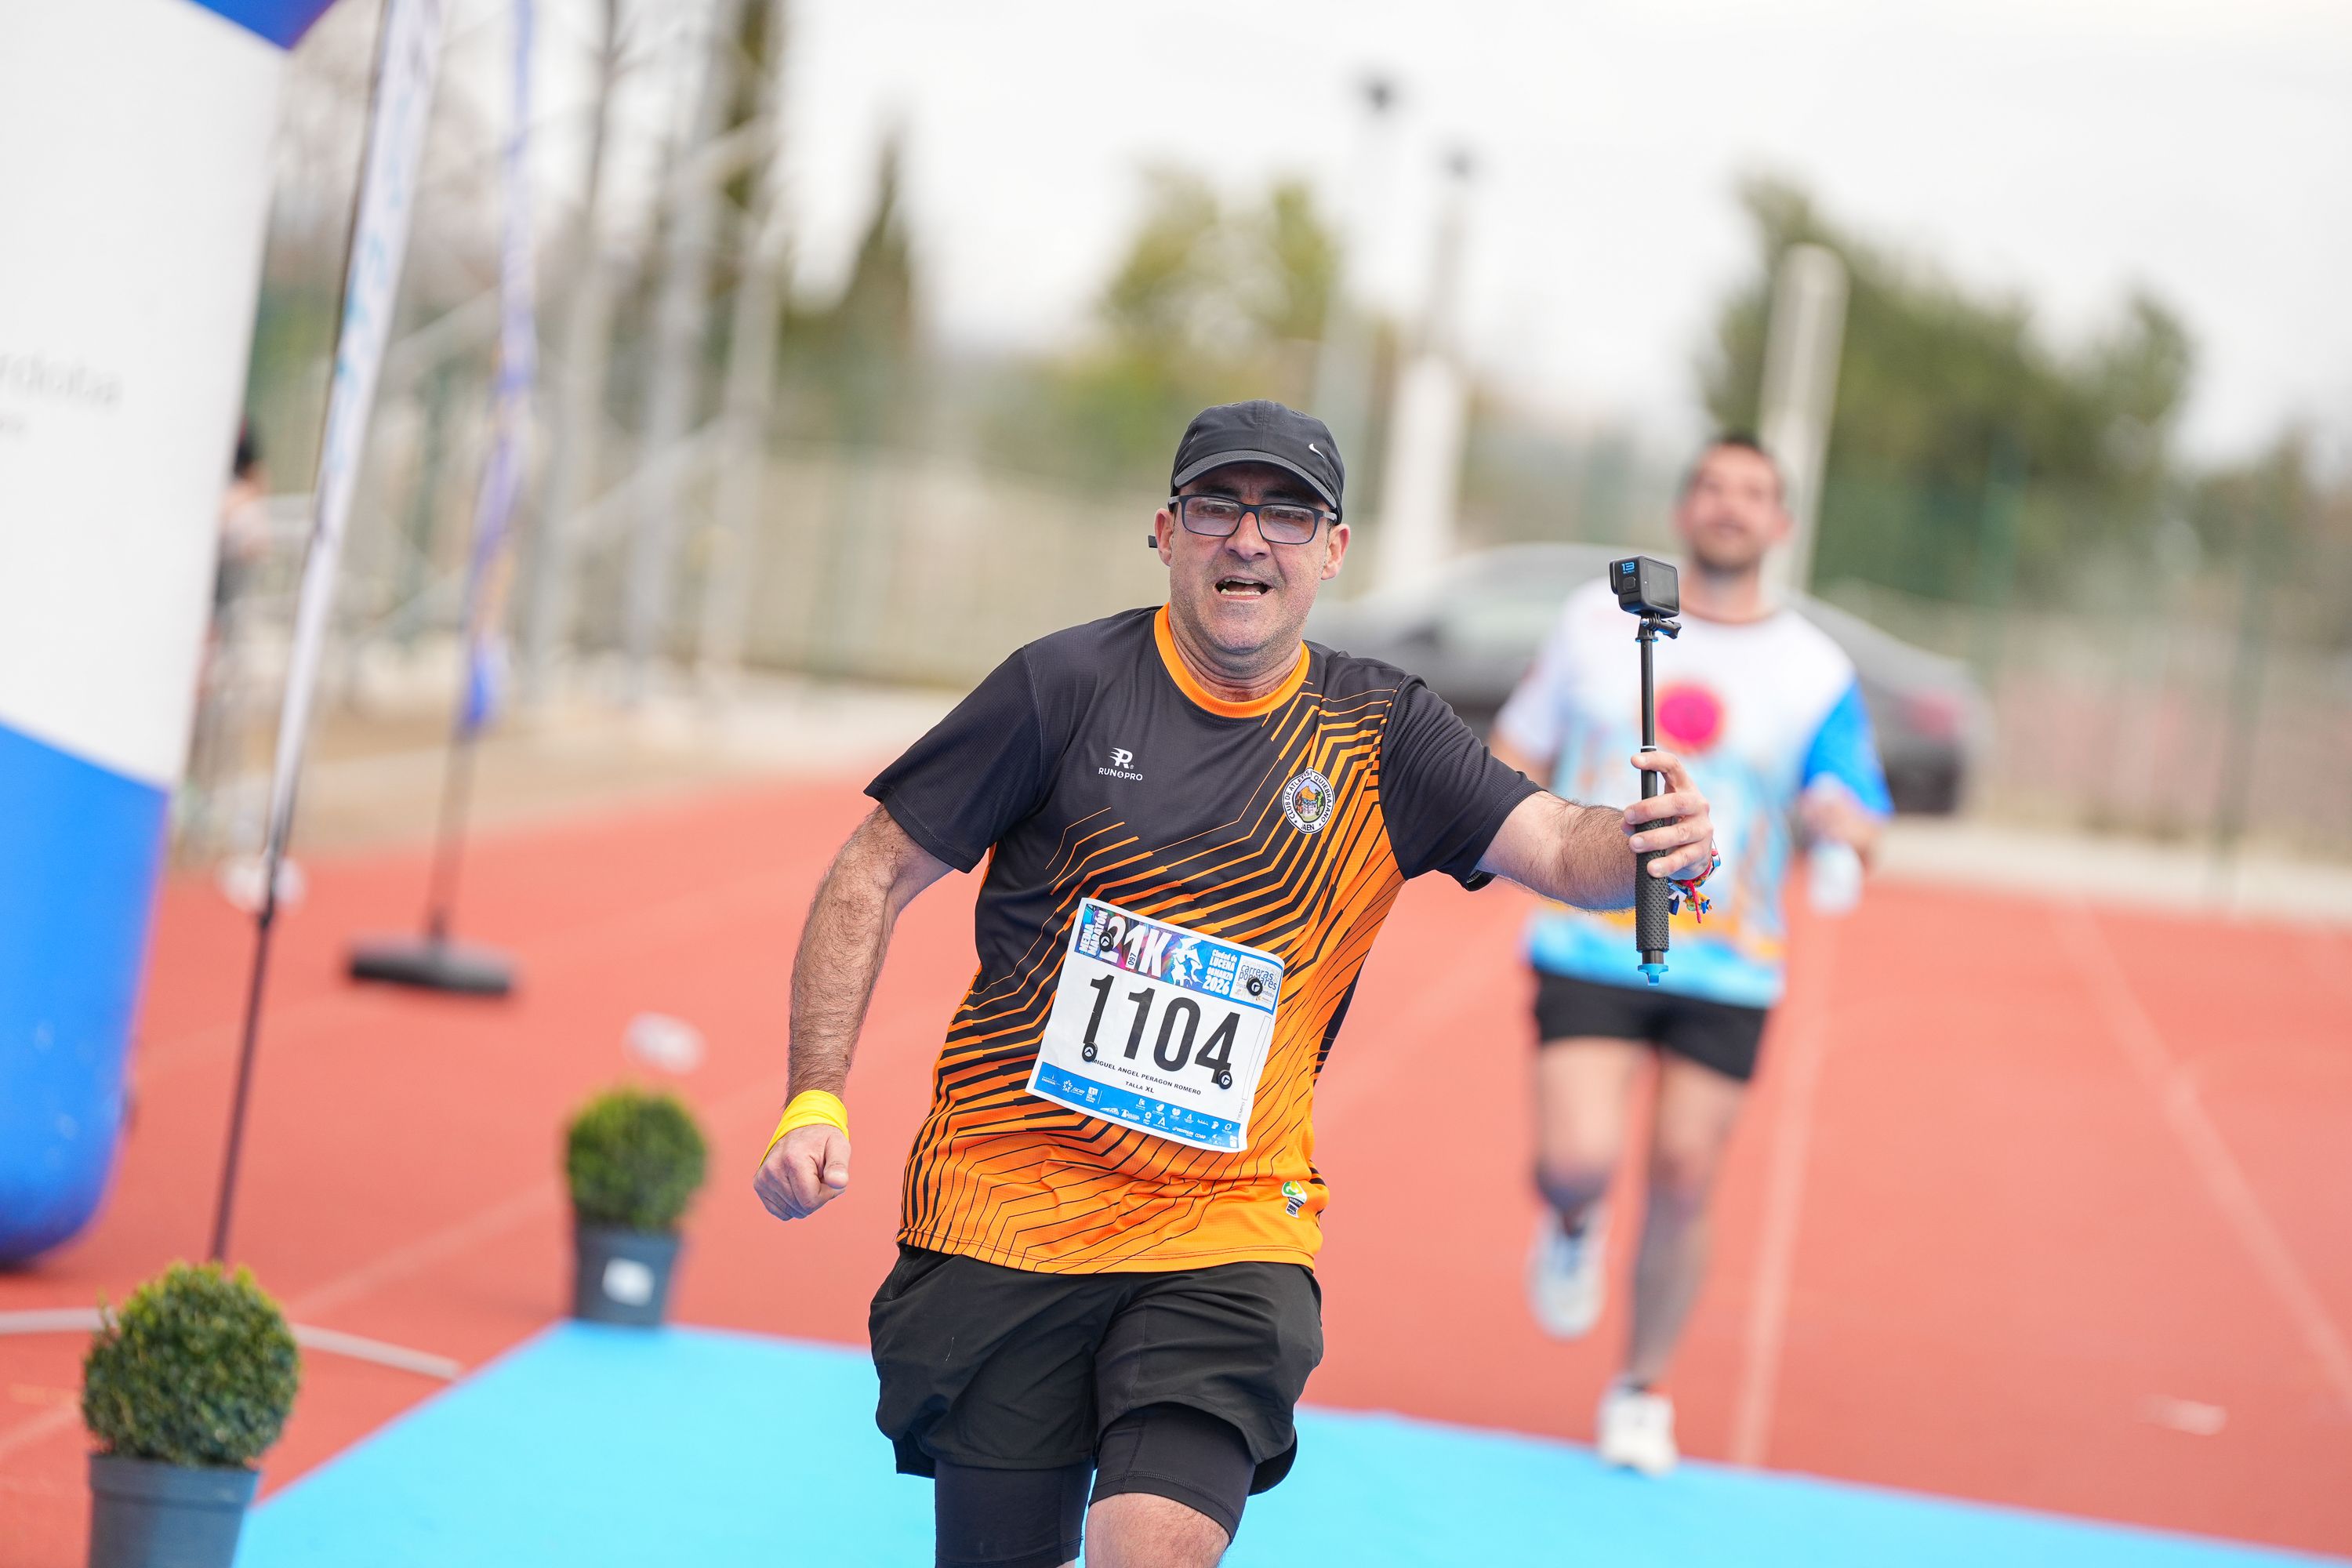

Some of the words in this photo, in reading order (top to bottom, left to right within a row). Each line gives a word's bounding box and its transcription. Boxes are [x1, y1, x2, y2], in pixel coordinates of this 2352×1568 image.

[1621, 561, 1635, 572] 13
[1285, 791, 1292, 800] DE
[1313, 775, 1332, 822] QUIEBRAJANO
[1285, 801, 1295, 819] CLUB
[1079, 924, 1094, 953] MEDIA
[1099, 916, 1173, 978] 21K
[1127, 953, 1137, 966] 097
[1209, 956, 1236, 971] LUCENA
[1238, 971, 1277, 990] poares
[1241, 964, 1274, 980] carreras
[1202, 975, 1230, 996] 2026
[1083, 975, 1241, 1084] 1104
[1091, 1058, 1116, 1070] MIGUEL
[1117, 1066, 1139, 1077] ANGEL
[1141, 1073, 1173, 1087] PERAGON
[1174, 1083, 1201, 1095] ROMERO
[1125, 1080, 1143, 1091] TALLA
